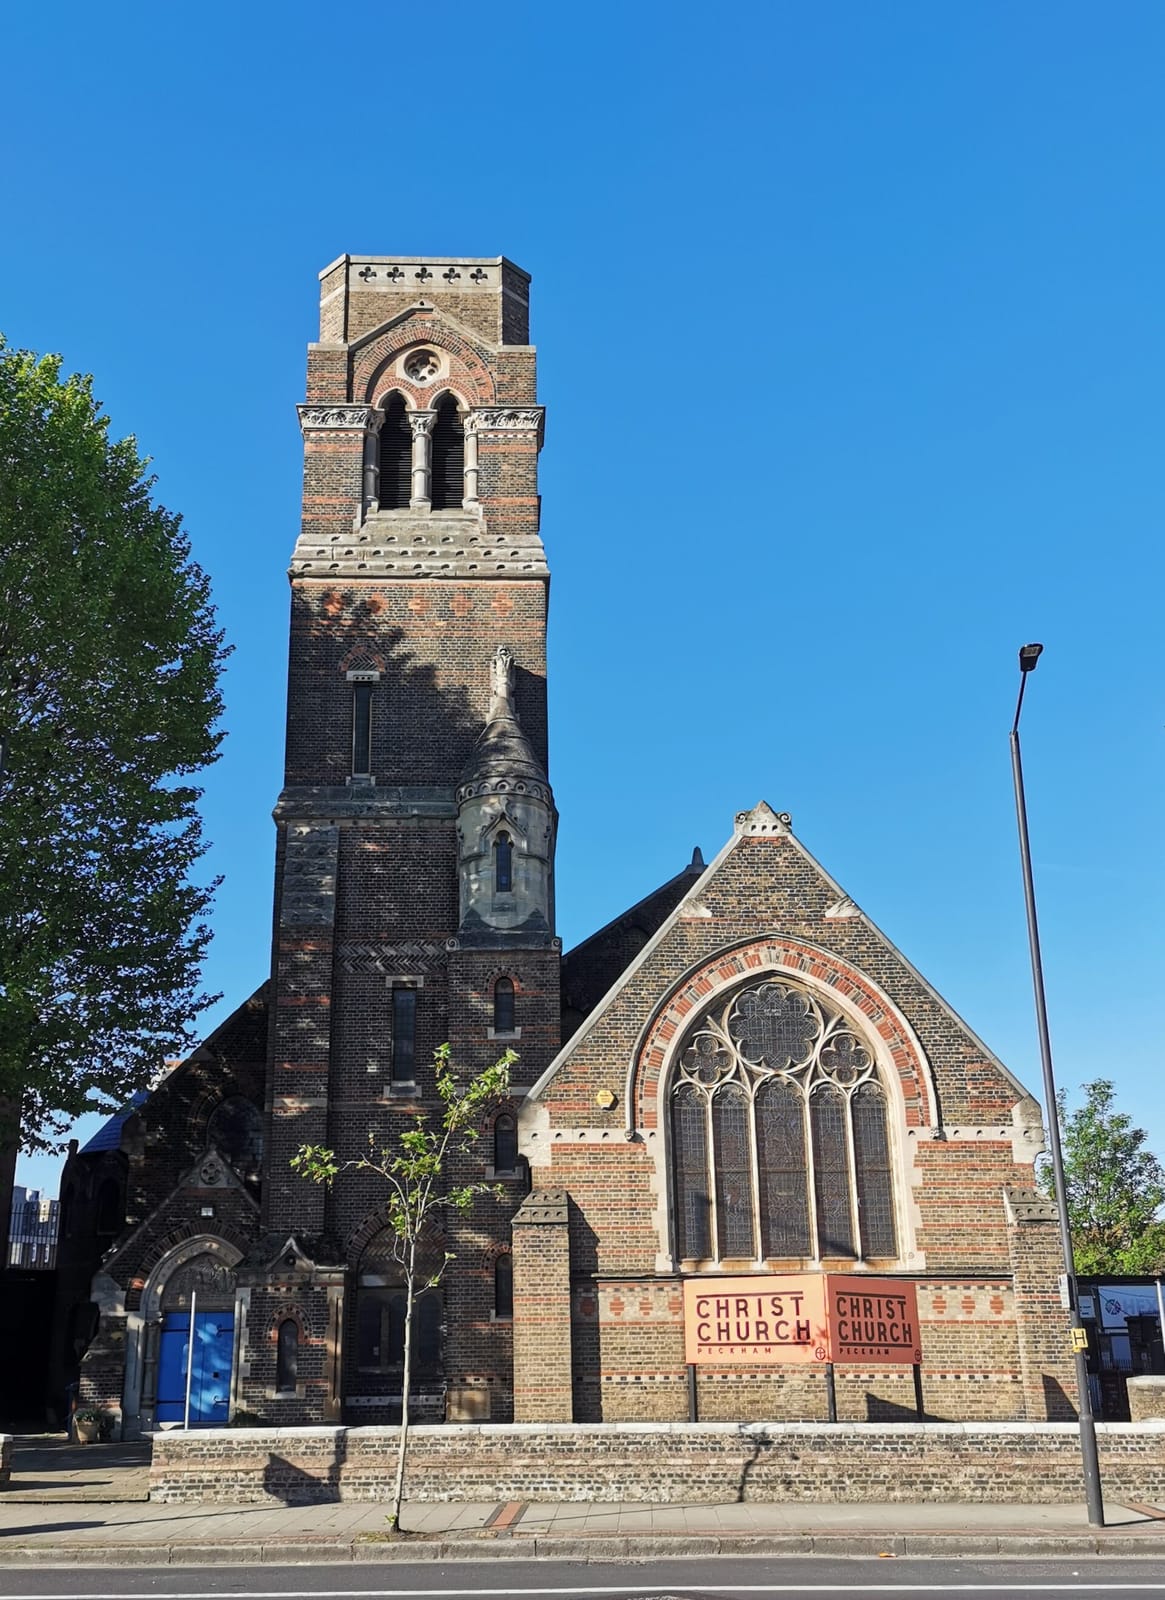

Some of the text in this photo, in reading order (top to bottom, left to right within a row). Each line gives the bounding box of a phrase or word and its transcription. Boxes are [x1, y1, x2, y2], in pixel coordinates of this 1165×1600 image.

[696, 1296, 804, 1319] CHRIST
[836, 1296, 906, 1320] CHRIST
[697, 1319, 811, 1341] CHURCH
[838, 1320, 913, 1343] CHURCH
[1073, 1330, 1086, 1346] H
[839, 1347, 890, 1355] PECKHAM
